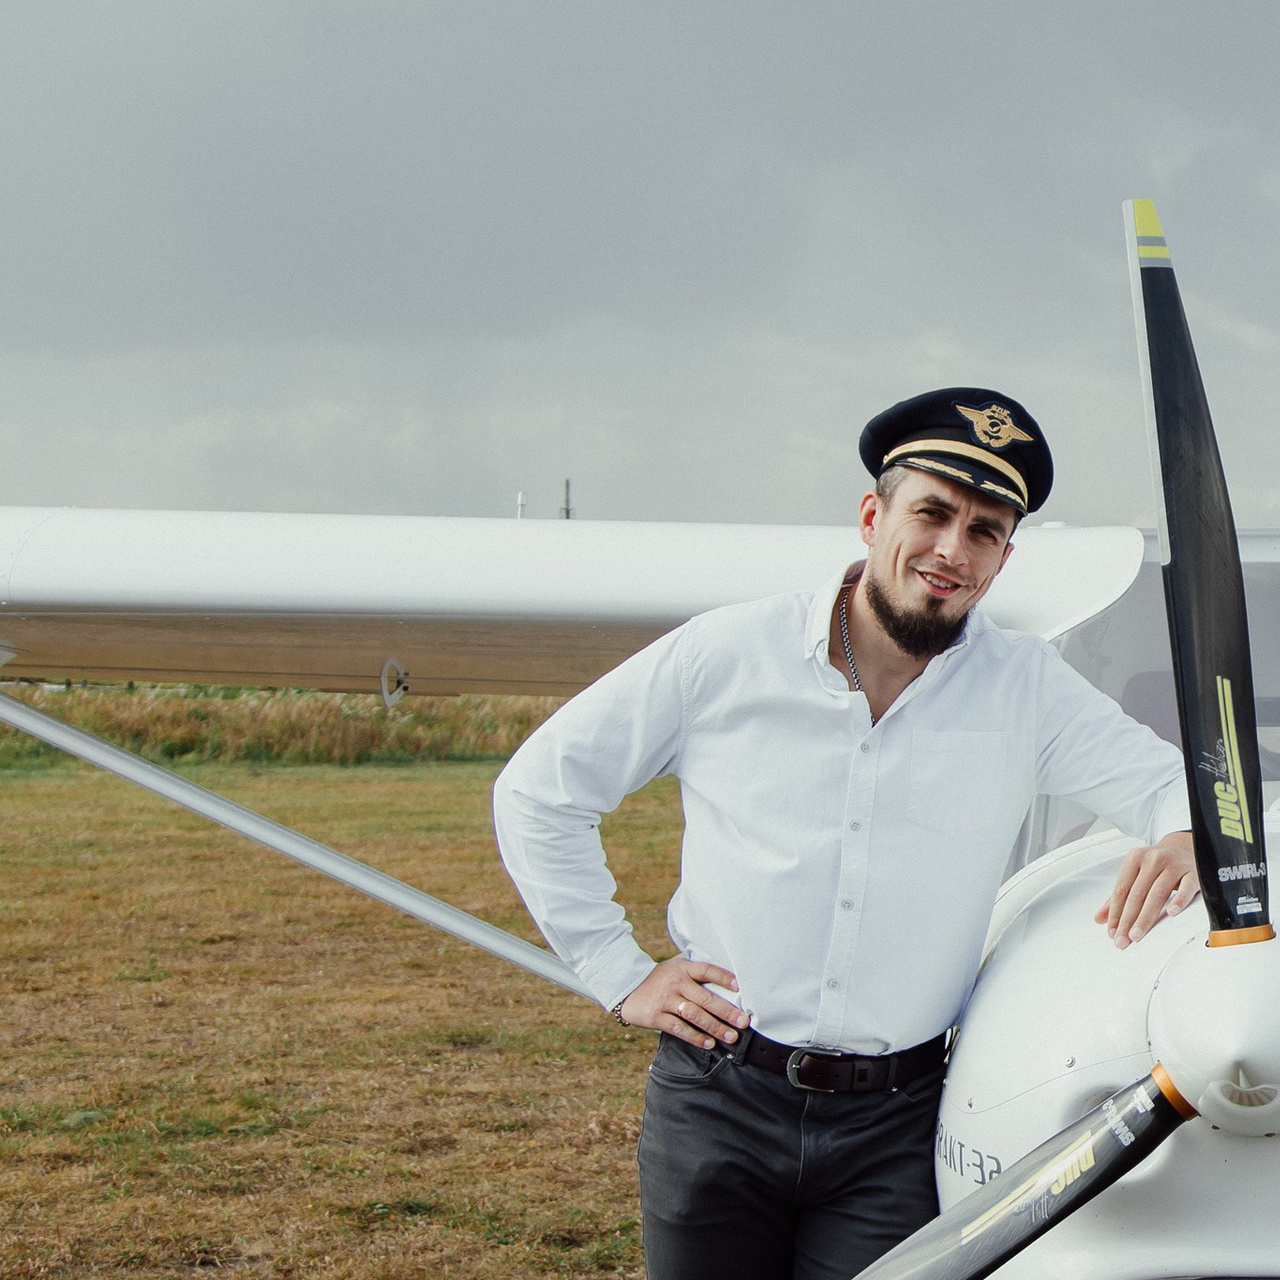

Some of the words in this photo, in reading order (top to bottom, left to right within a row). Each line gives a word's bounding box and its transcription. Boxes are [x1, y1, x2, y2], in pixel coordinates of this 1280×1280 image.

[1214, 780, 1244, 841] DUC
[1217, 861, 1266, 882] SWIRL-3
[1050, 1142, 1096, 1196] DUC
